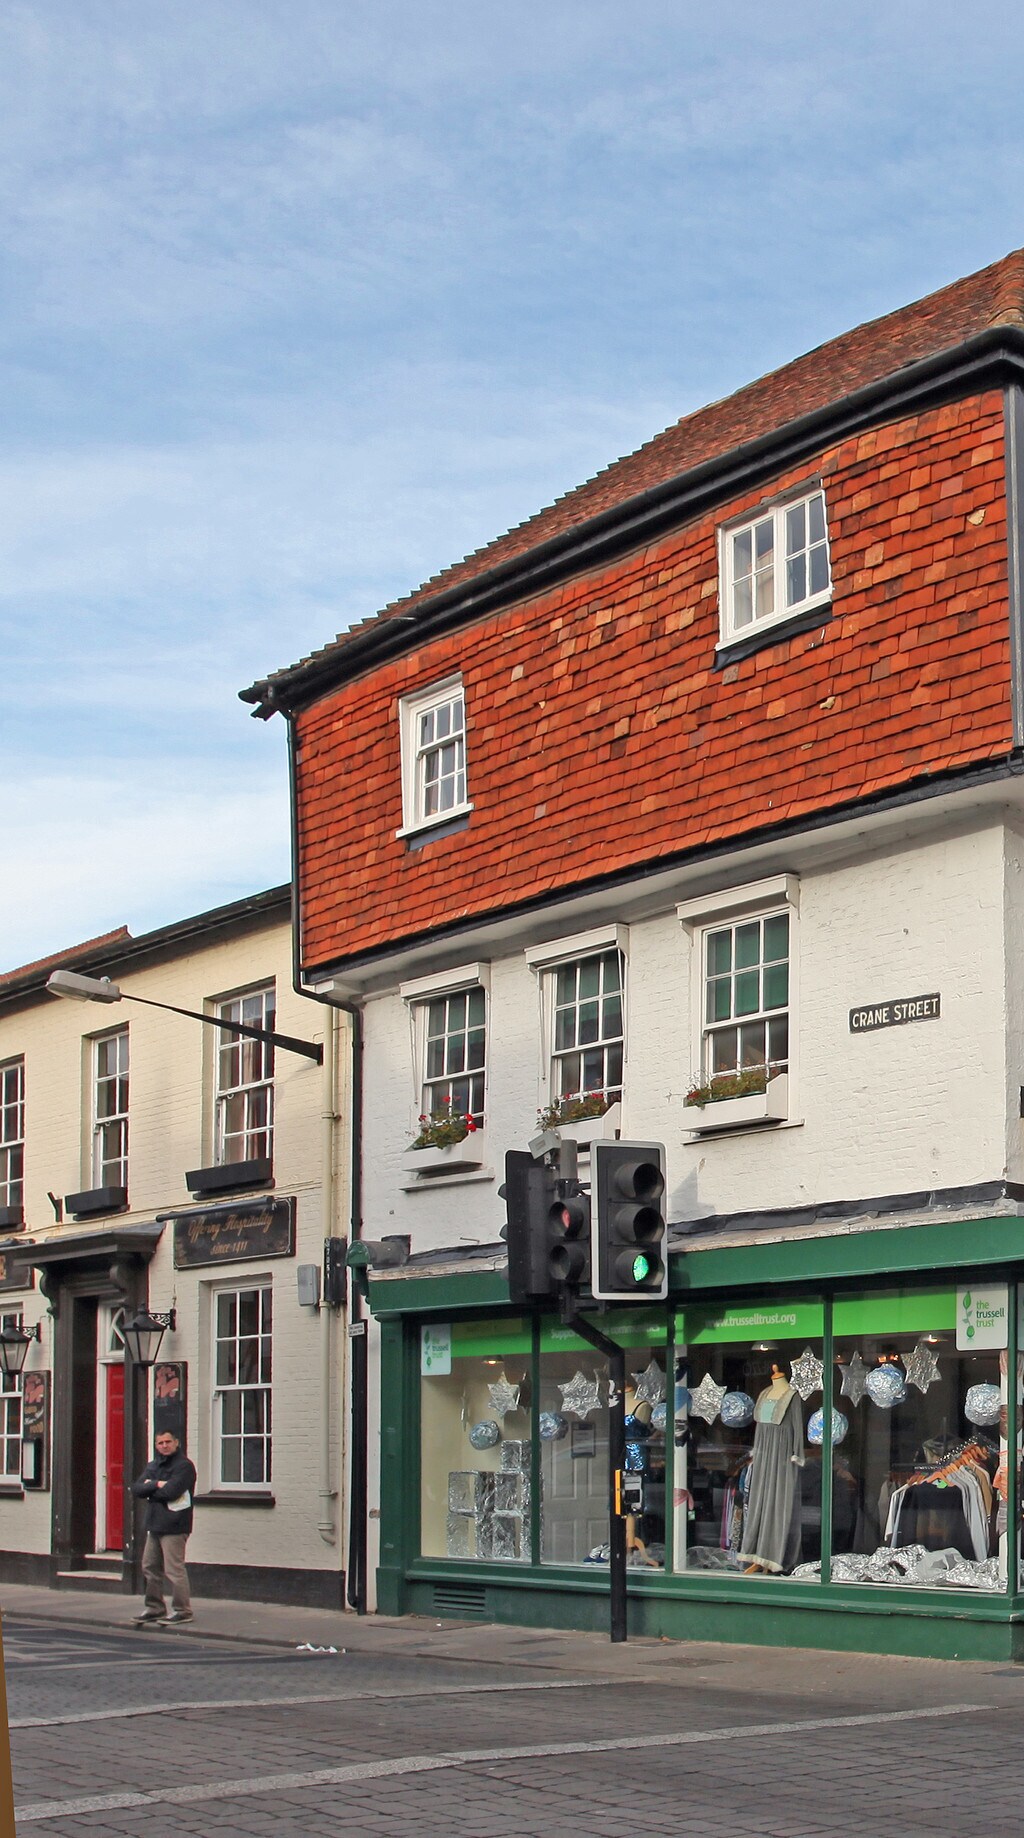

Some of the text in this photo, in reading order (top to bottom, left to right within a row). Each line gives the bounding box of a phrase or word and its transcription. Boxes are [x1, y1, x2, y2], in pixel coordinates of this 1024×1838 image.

[852, 998, 938, 1028] CRANE STREET
[188, 1208, 273, 1243] Offering Hospitality
[976, 1300, 990, 1309] the
[976, 1307, 1005, 1318] trussell
[976, 1319, 995, 1327] trust
